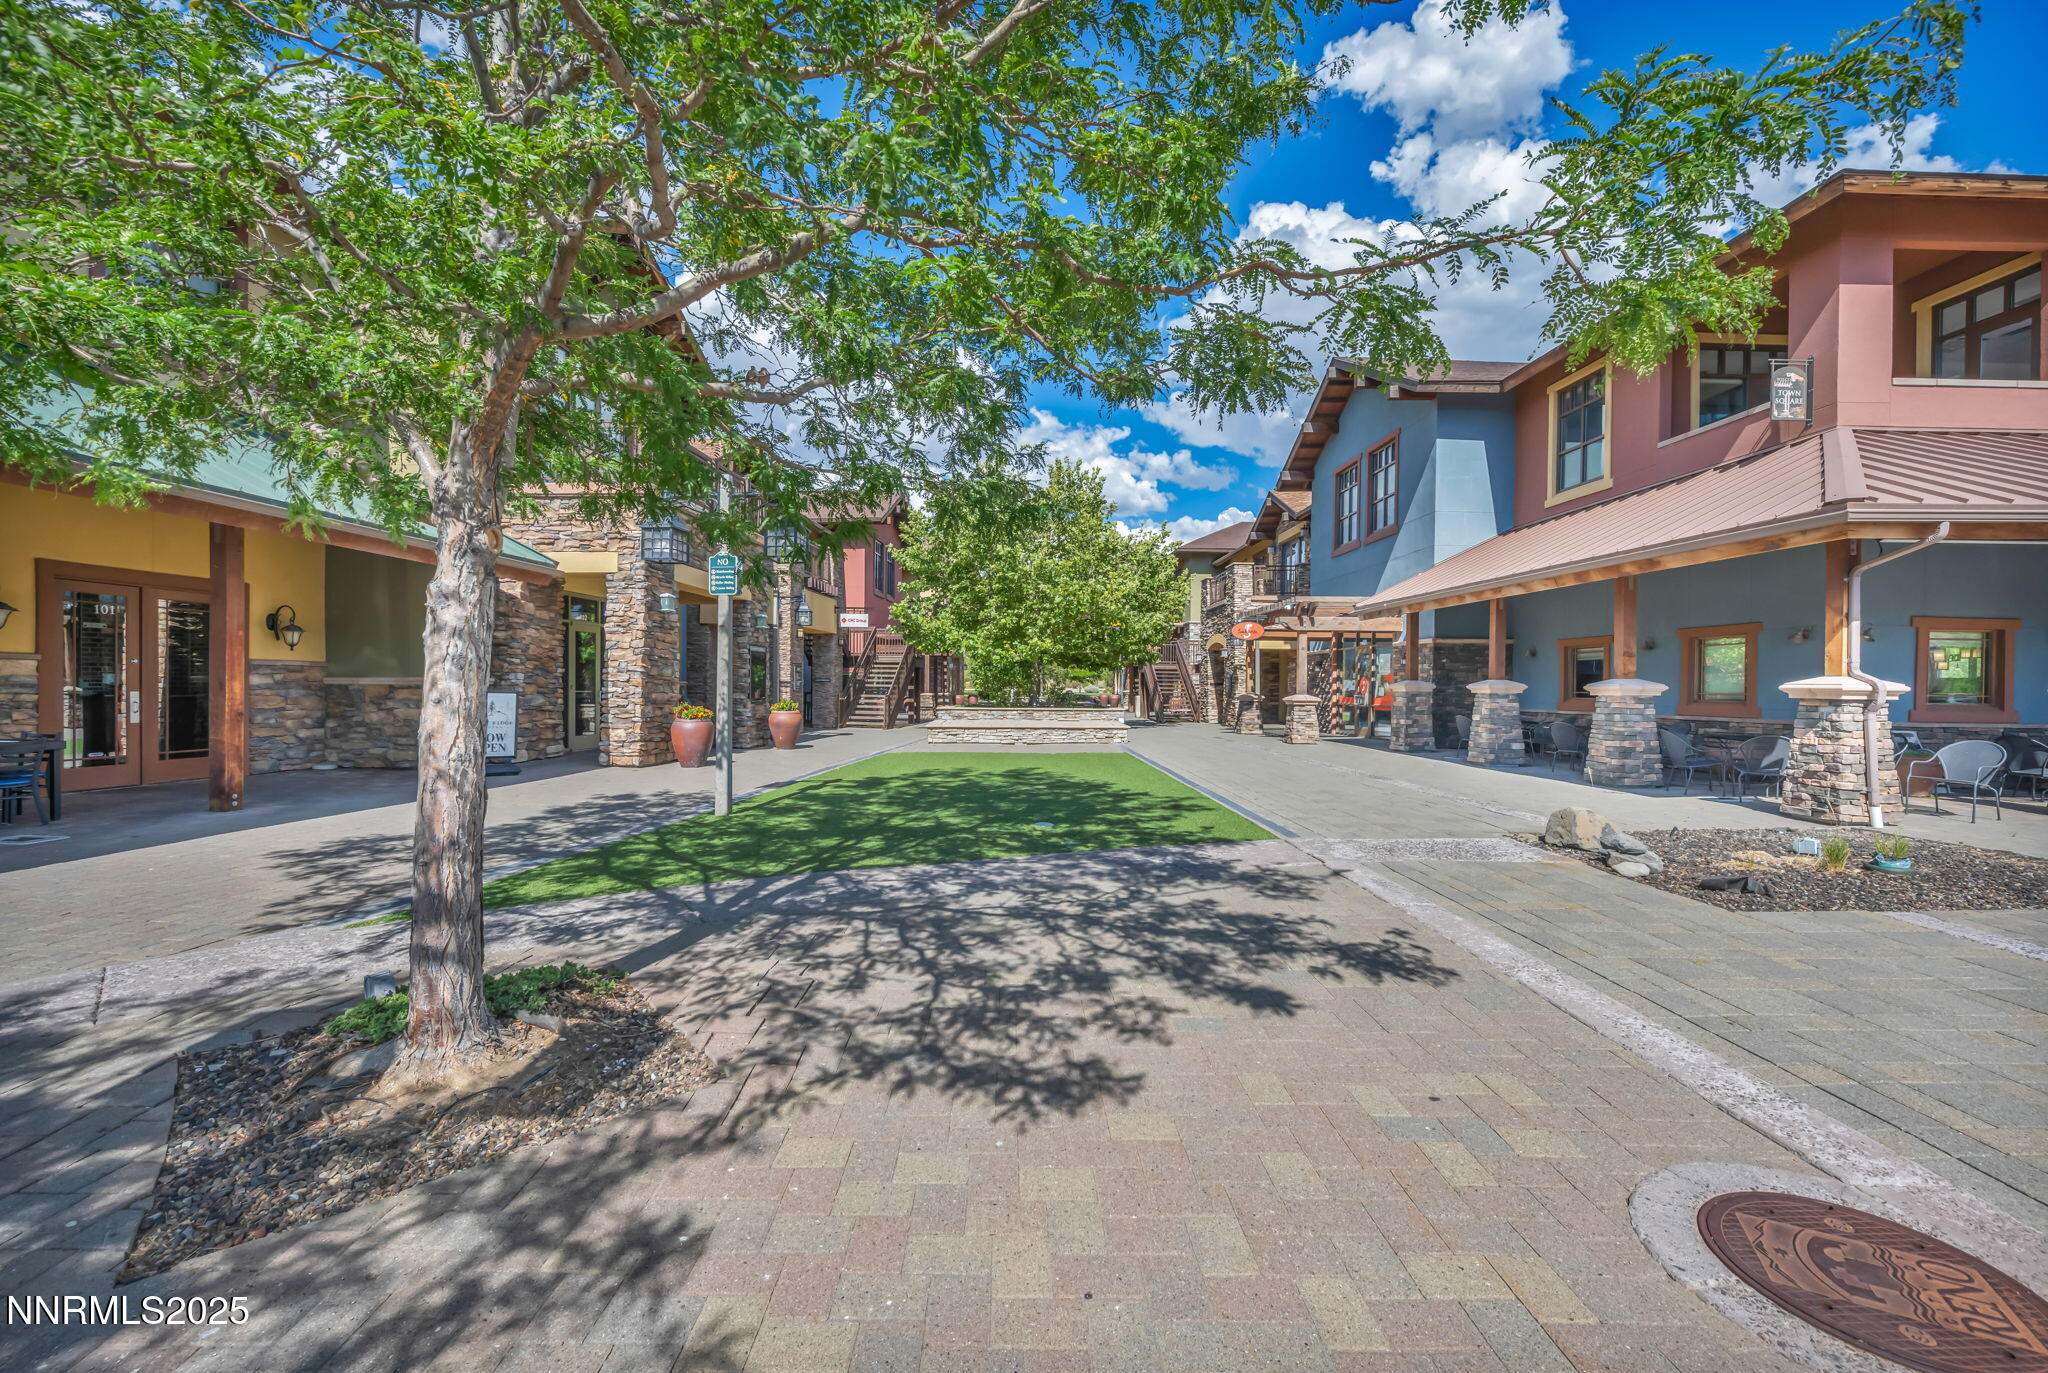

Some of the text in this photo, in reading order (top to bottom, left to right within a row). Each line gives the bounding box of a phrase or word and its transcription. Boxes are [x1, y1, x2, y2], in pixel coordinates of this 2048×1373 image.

[1777, 389, 1801, 397] TOWN
[717, 558, 729, 566] NO
[94, 604, 115, 615] 101
[486, 733, 507, 742] OW
[486, 743, 507, 752] PEN
[1916, 1259, 2034, 1348] RENO
